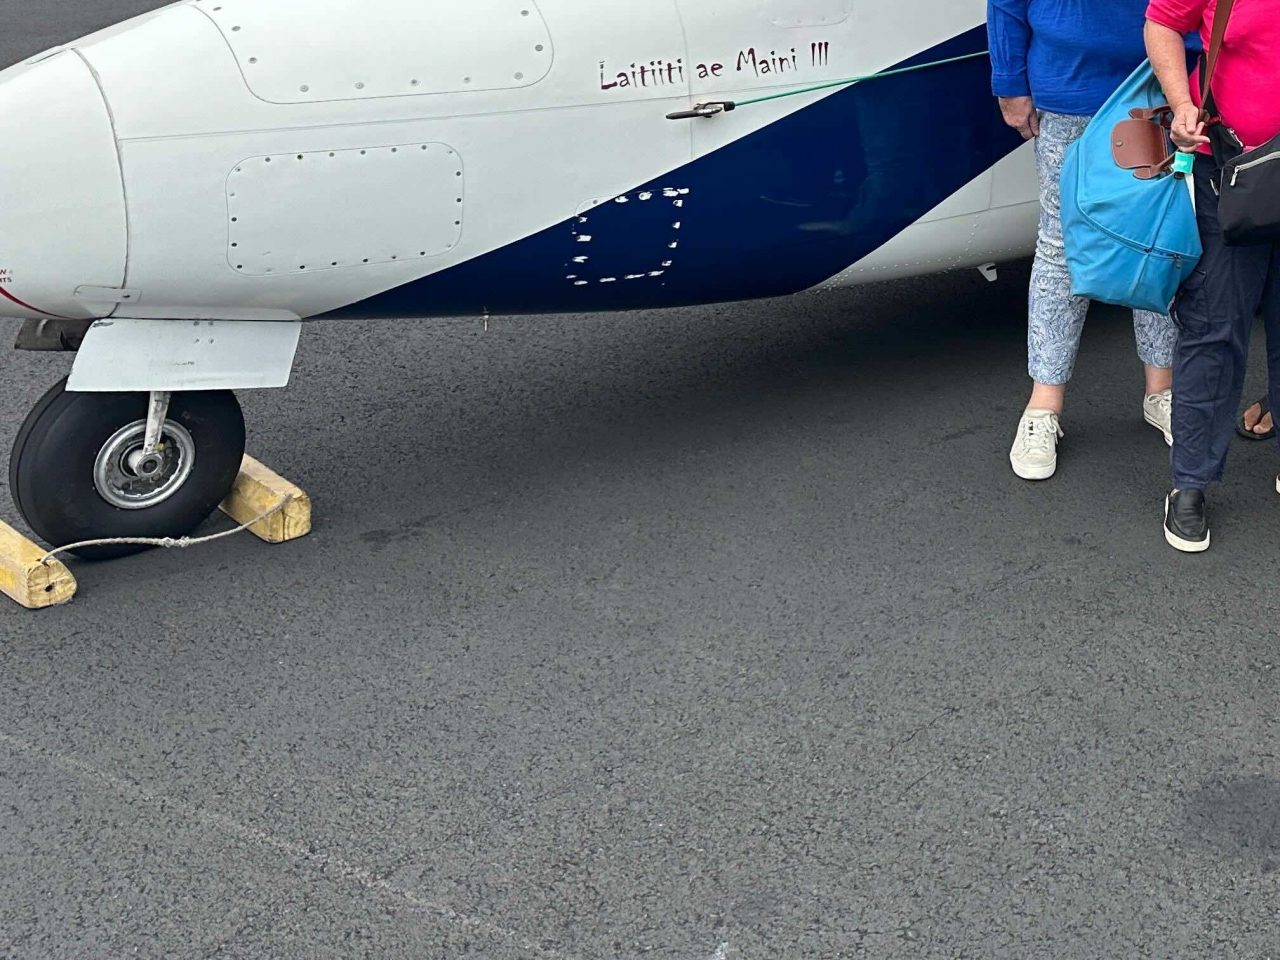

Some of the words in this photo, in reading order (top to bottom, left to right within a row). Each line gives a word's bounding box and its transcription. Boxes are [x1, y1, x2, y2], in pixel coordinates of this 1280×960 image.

[599, 57, 684, 90] Laitiiti
[695, 62, 724, 79] ae
[735, 47, 798, 78] Maini
